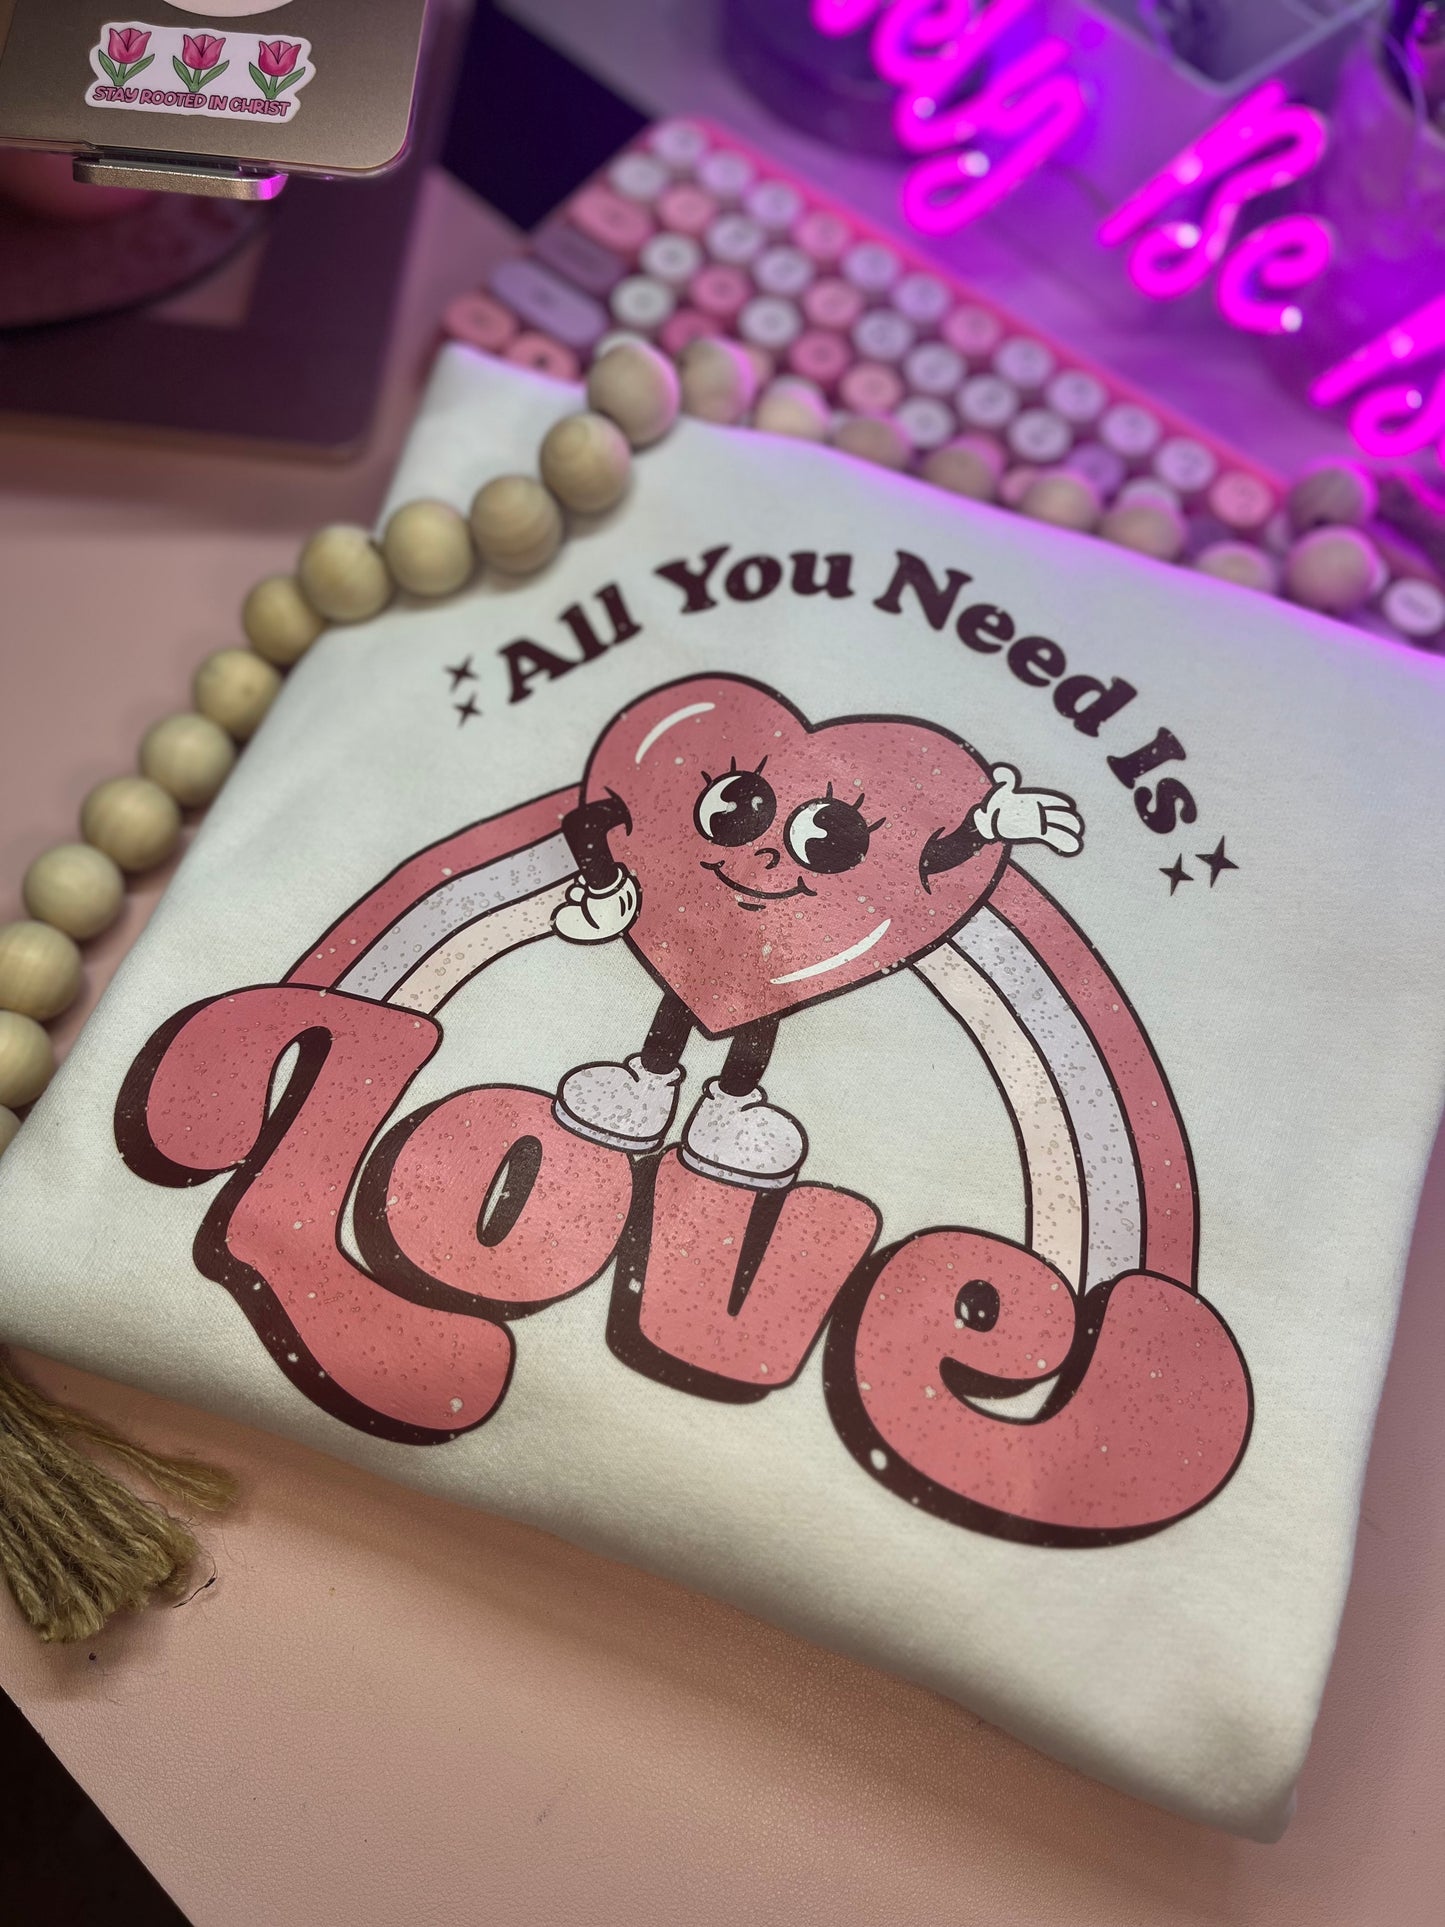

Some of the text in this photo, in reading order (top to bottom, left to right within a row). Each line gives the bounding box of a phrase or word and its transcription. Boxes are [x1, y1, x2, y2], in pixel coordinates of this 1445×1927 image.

[92, 86, 291, 117] STAY ROOTED IN CHRIST
[498, 544, 1198, 834] All You Need Is
[114, 983, 1254, 1549] Love
